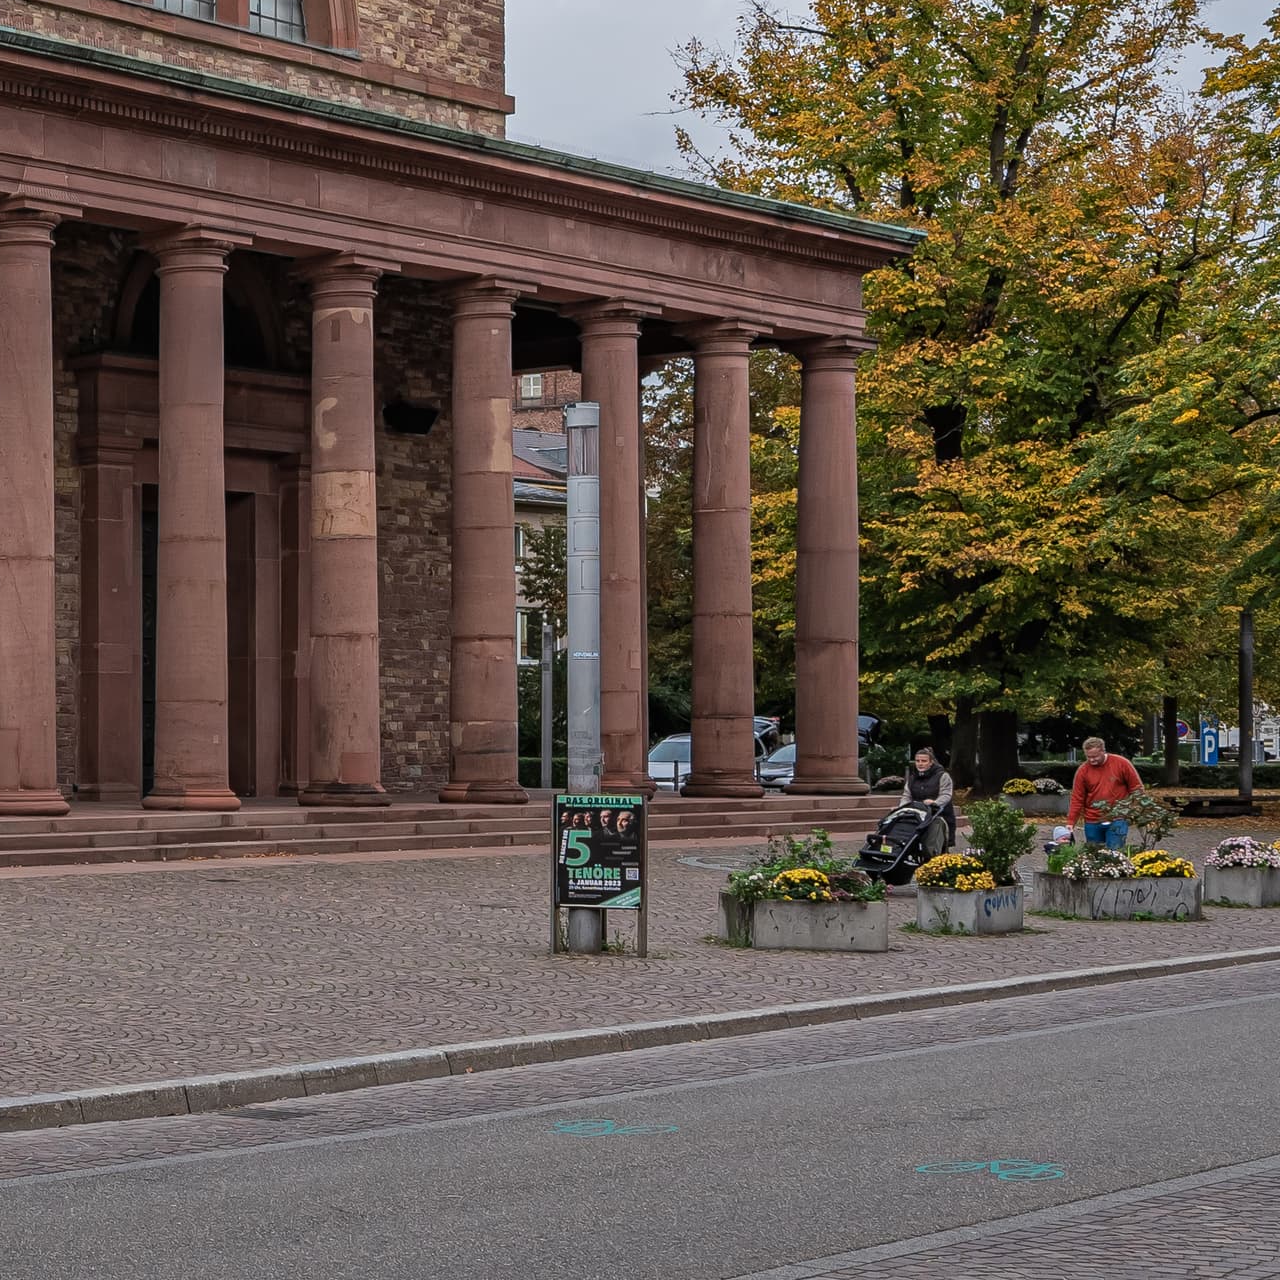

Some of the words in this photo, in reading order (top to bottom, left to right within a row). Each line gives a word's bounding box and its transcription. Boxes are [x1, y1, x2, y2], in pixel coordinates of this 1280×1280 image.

[1204, 735, 1216, 762] P
[587, 797, 632, 805] ORIGINAL
[565, 830, 592, 866] 5
[567, 864, 620, 879] TENÖRE
